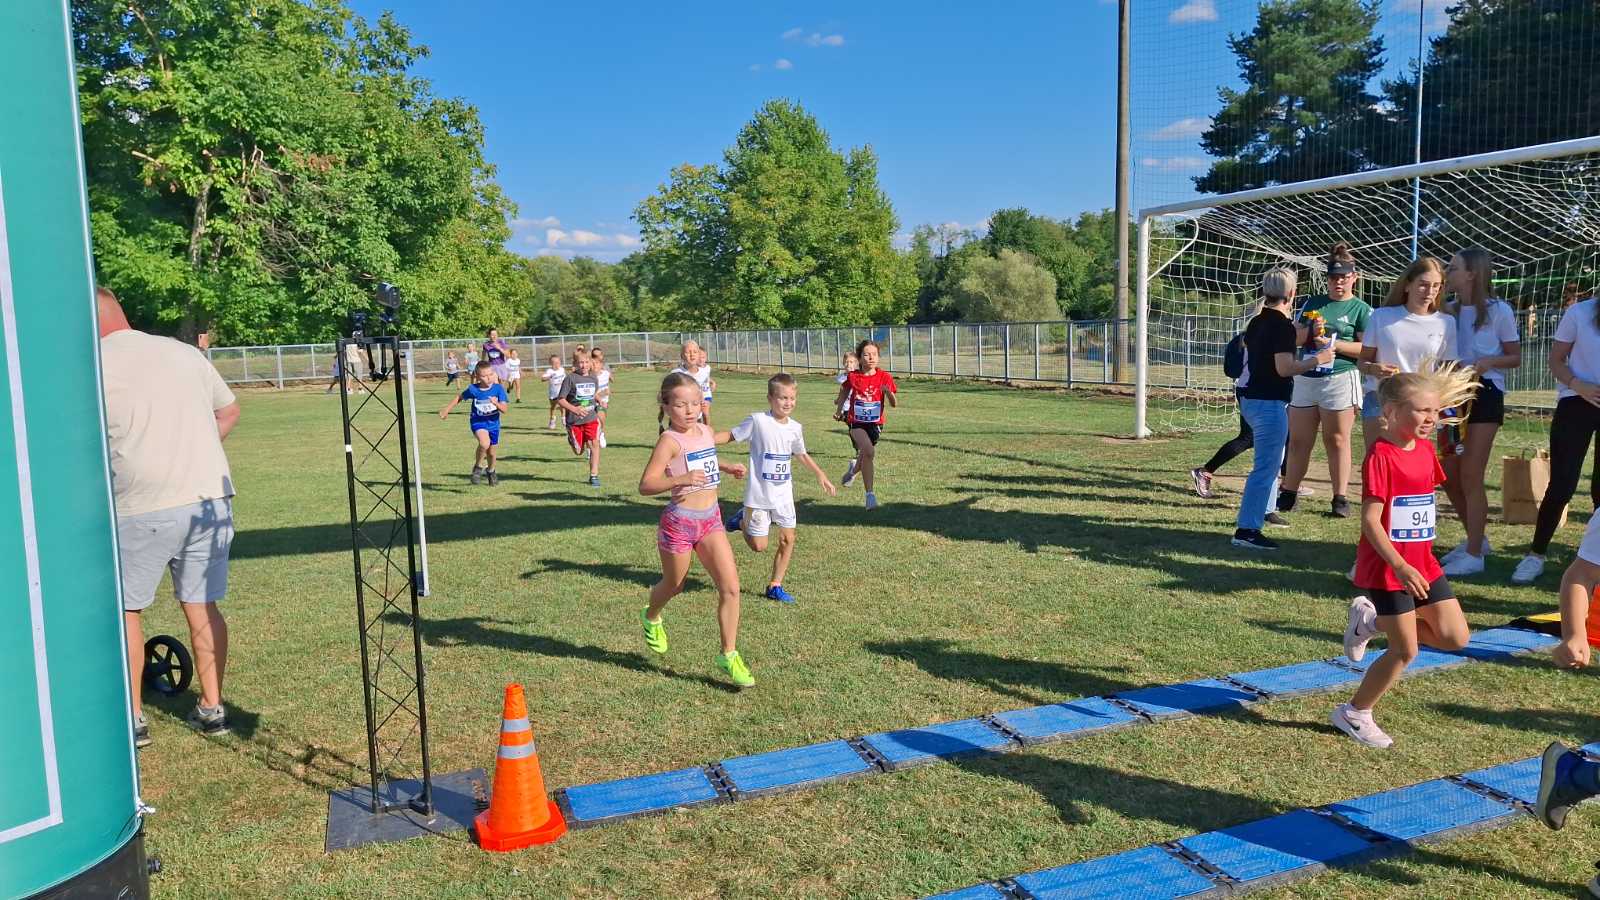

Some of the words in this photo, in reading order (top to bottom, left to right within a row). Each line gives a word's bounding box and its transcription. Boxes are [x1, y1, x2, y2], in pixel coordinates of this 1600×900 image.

[703, 460, 717, 474] 52
[775, 463, 787, 473] 50
[1411, 510, 1428, 526] 94
